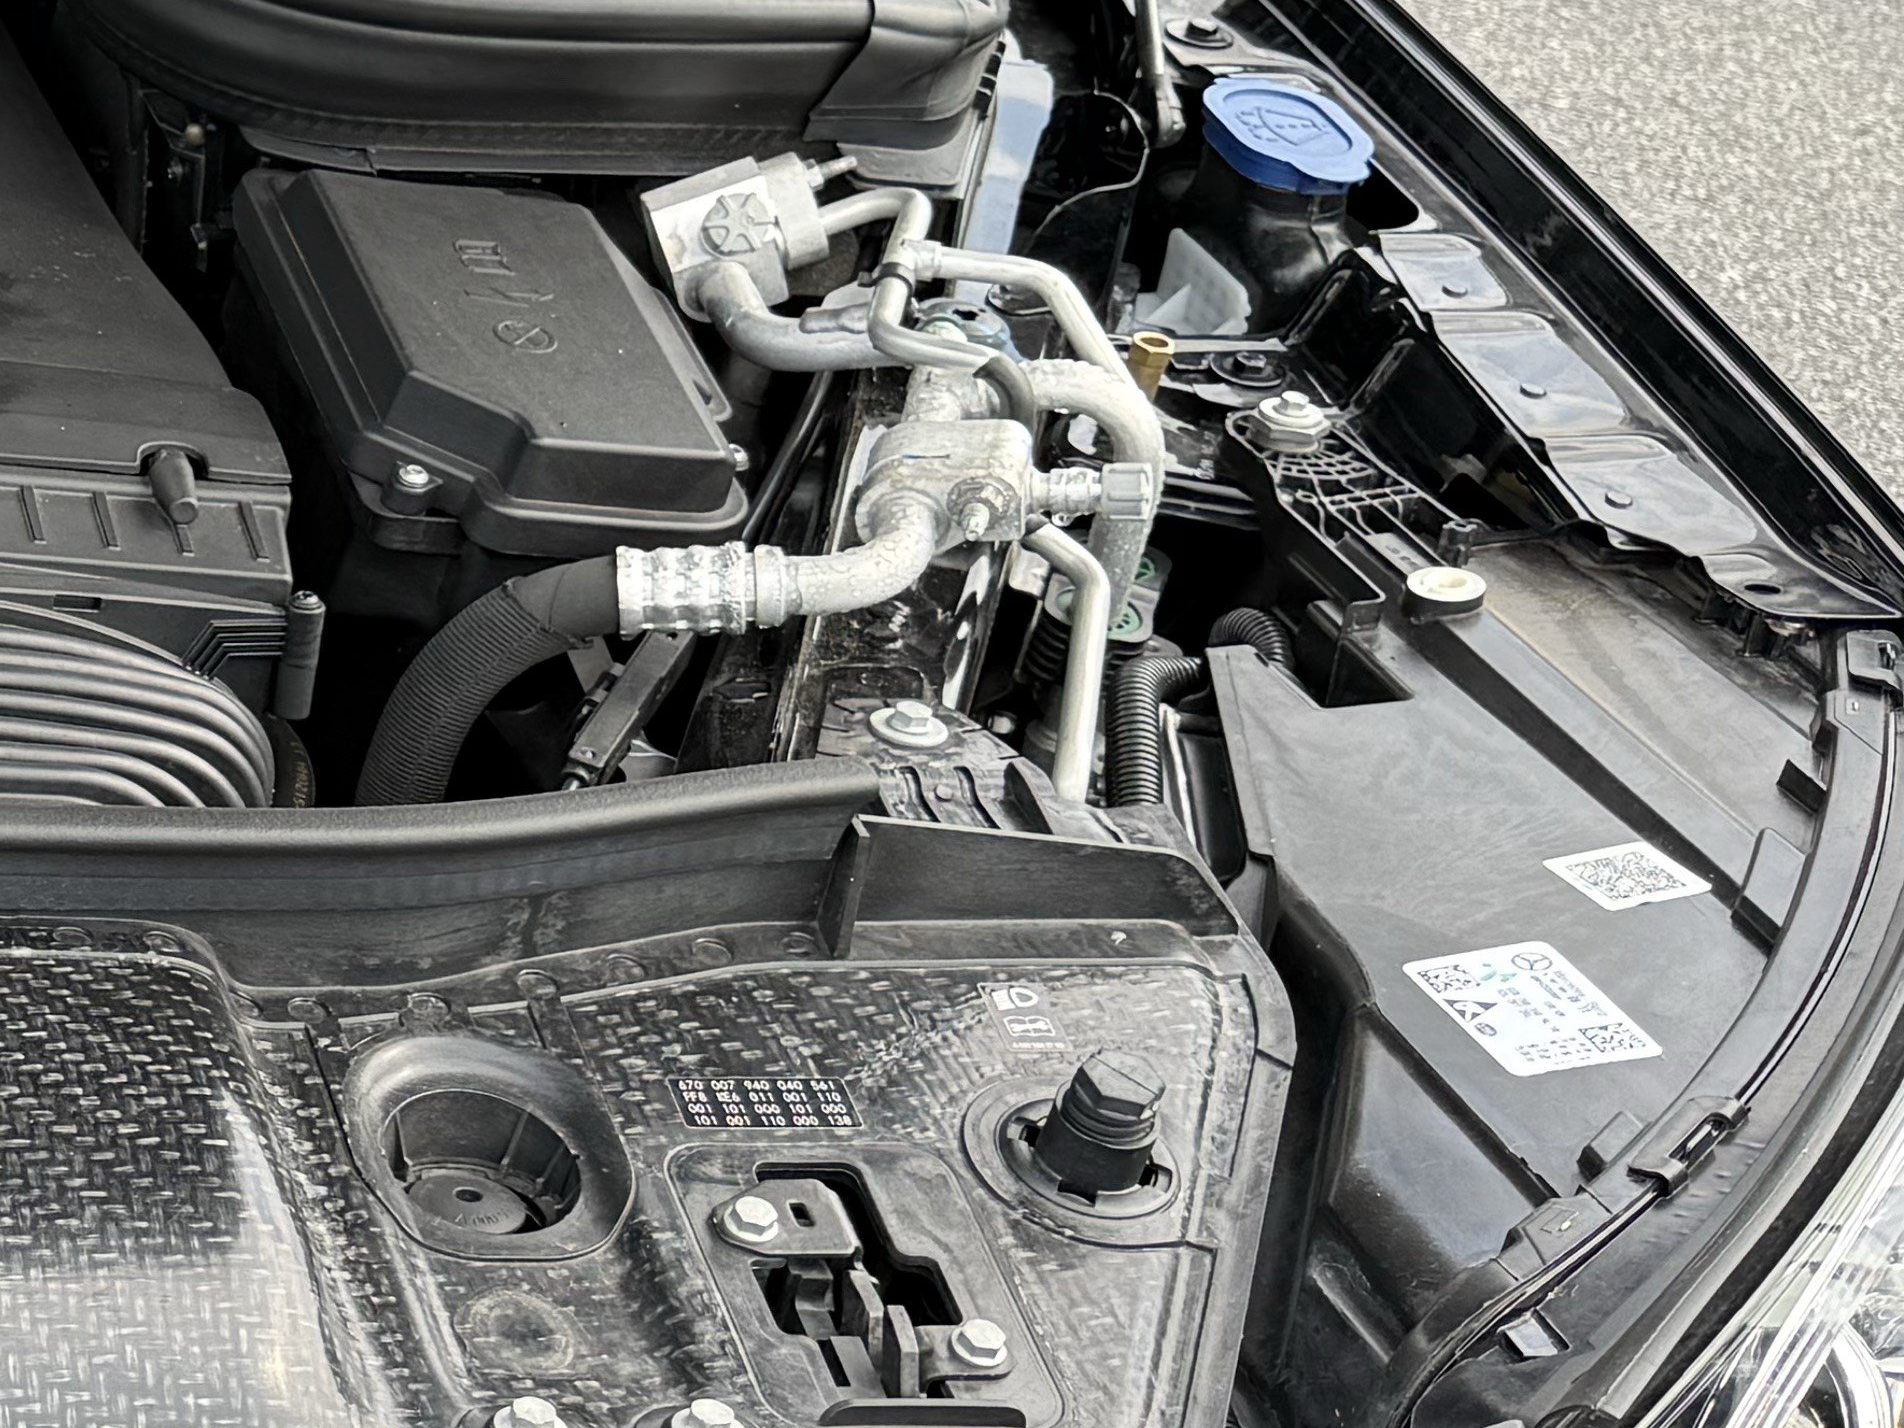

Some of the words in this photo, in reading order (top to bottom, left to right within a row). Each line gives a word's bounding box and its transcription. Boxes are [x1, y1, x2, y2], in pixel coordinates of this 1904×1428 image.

[710, 1080, 735, 1091] 007
[748, 1092, 775, 1102] 011
[782, 1092, 808, 1102] 001
[816, 1092, 842, 1102] 110
[687, 1103, 713, 1114] 001
[721, 1103, 746, 1114] 101
[754, 1103, 781, 1114] 000
[788, 1103, 813, 1114] 101
[820, 1103, 847, 1114] 000
[694, 1115, 718, 1126] 101
[725, 1115, 751, 1126] 001
[760, 1115, 786, 1126] 110
[792, 1115, 819, 1126] 000
